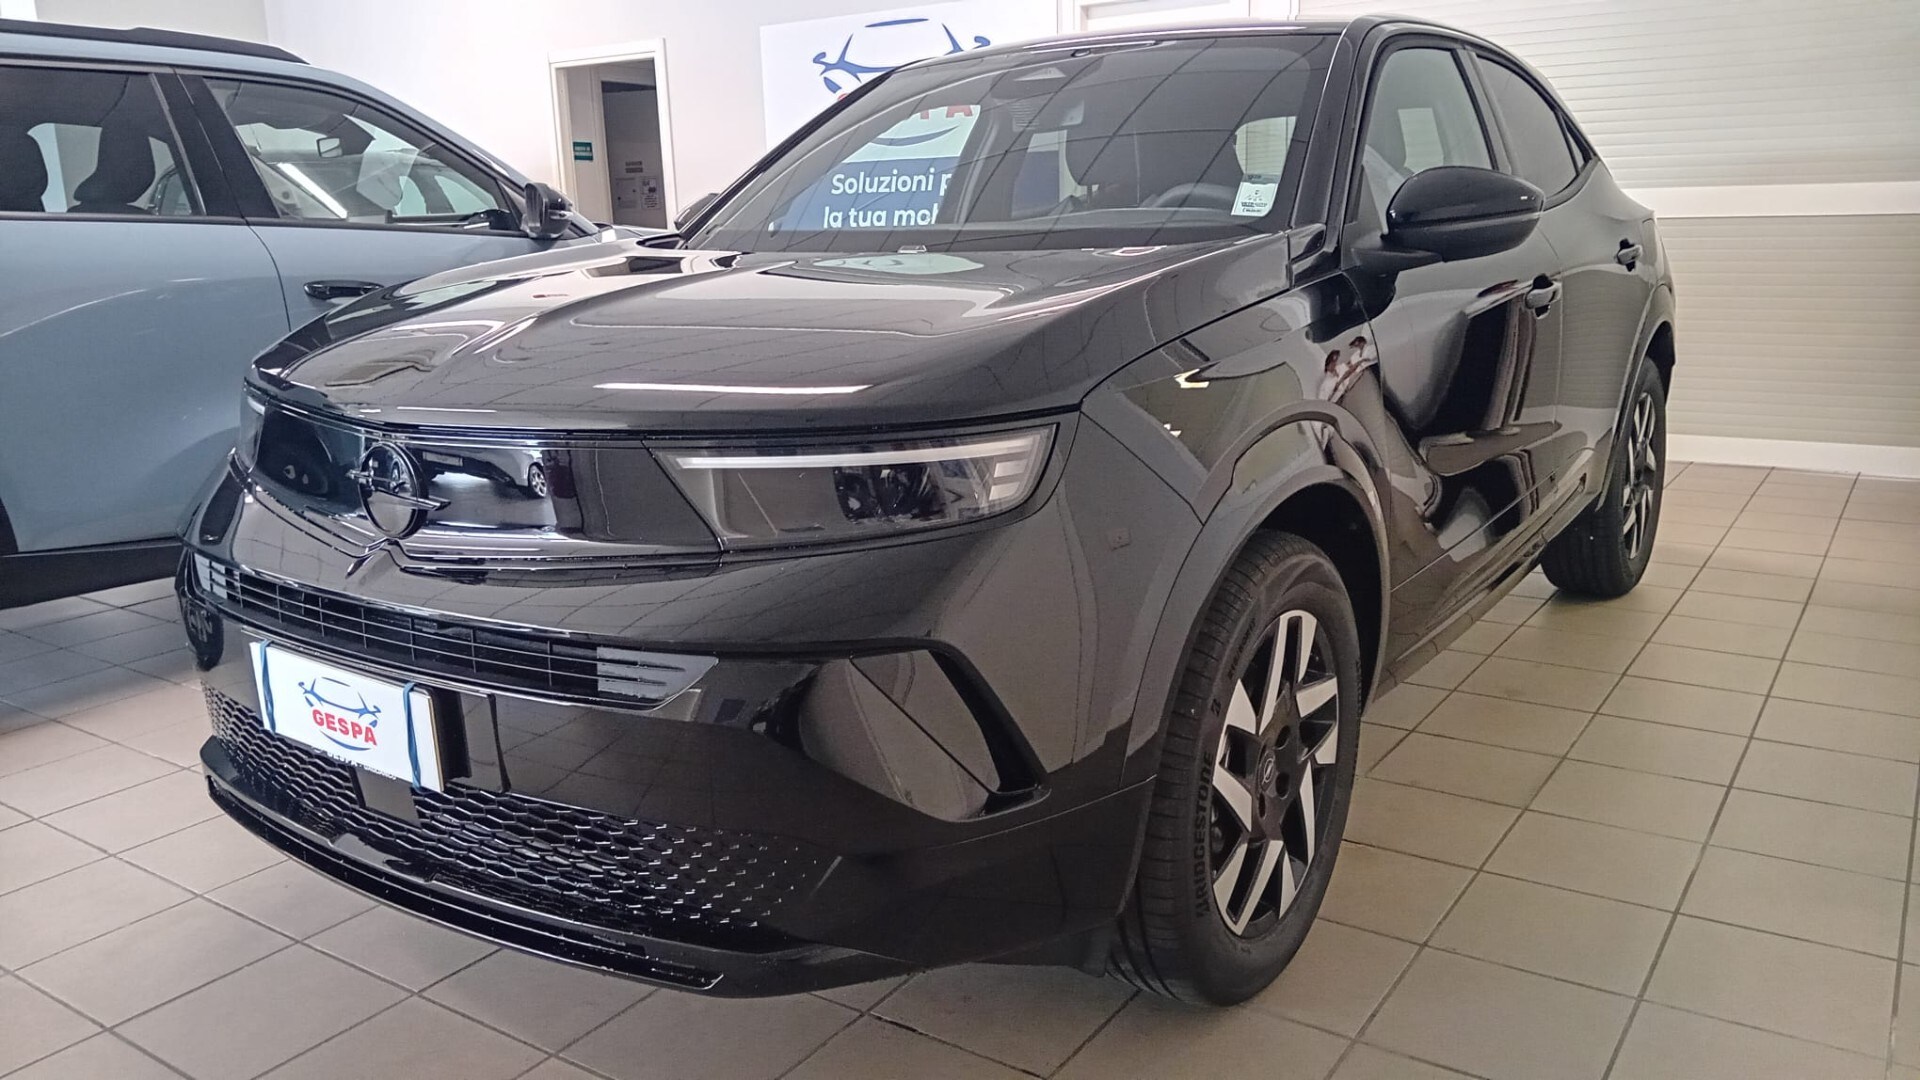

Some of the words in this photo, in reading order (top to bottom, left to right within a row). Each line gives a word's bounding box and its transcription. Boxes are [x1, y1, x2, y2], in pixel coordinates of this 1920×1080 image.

[831, 167, 934, 195] Soluzioni
[823, 205, 843, 229] la
[848, 207, 887, 228] tua
[312, 709, 377, 746] GESPA
